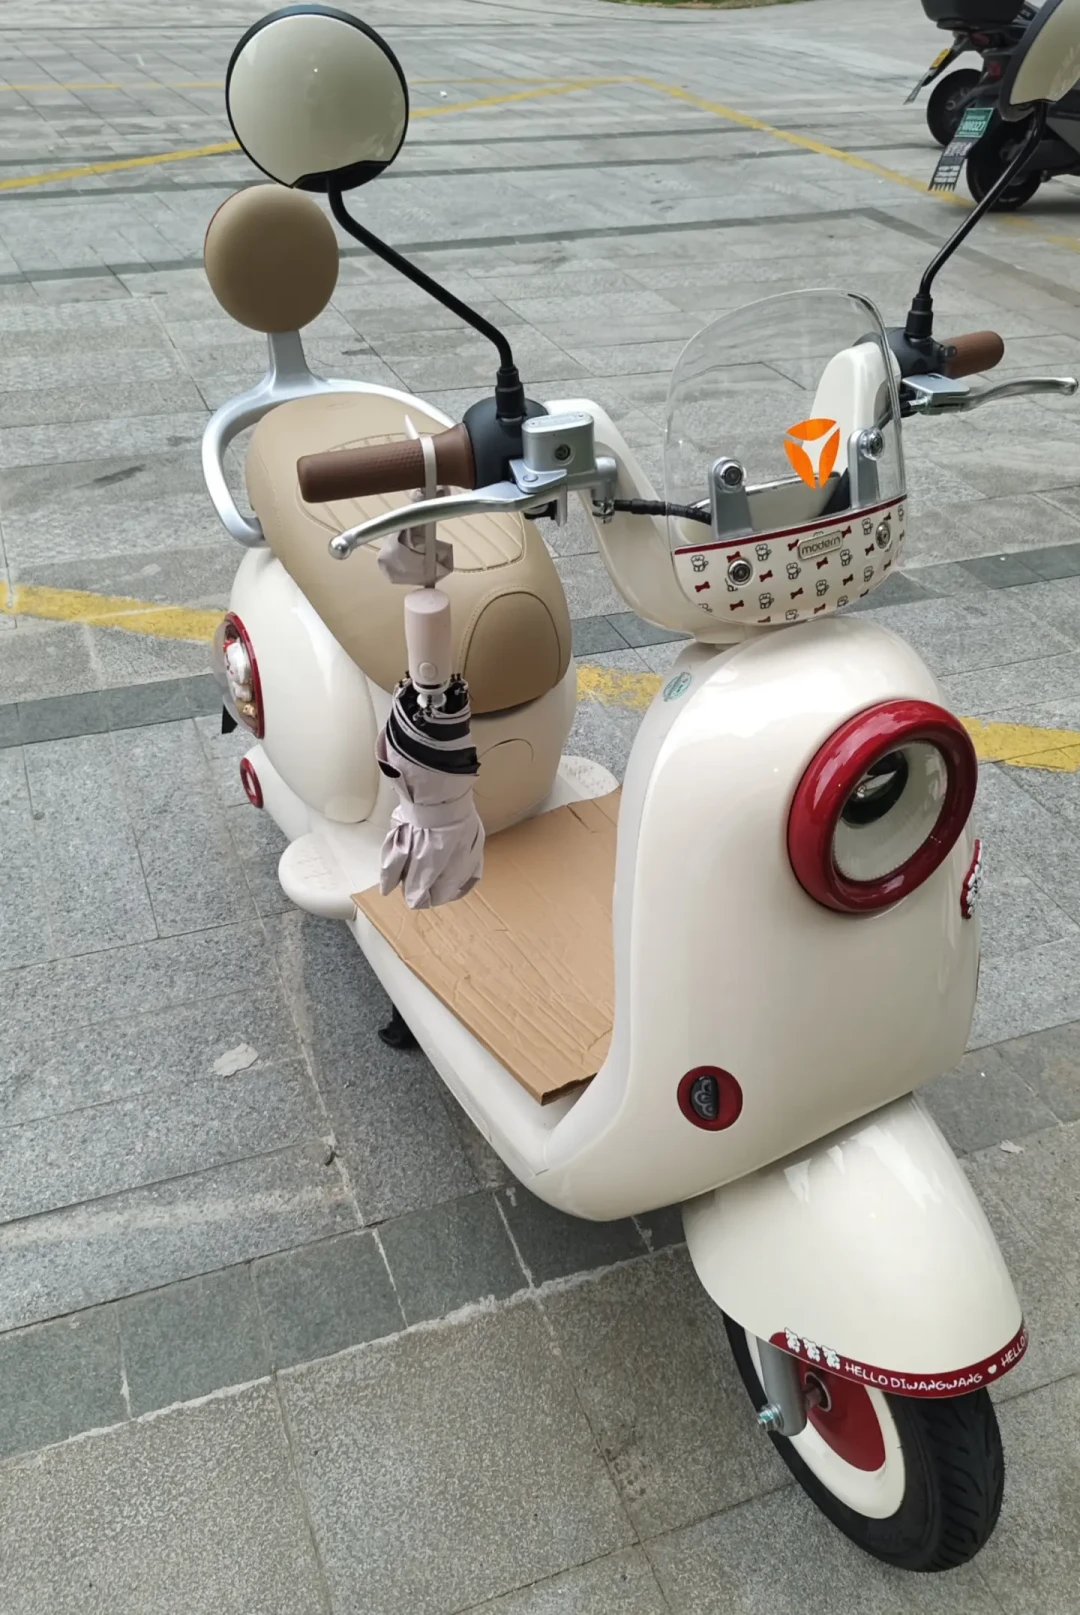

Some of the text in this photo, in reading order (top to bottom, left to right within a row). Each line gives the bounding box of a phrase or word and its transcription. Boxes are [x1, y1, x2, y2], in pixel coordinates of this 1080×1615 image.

[801, 536, 841, 555] modern
[844, 1361, 889, 1386] HELLO
[1001, 1335, 1026, 1368] HELLO
